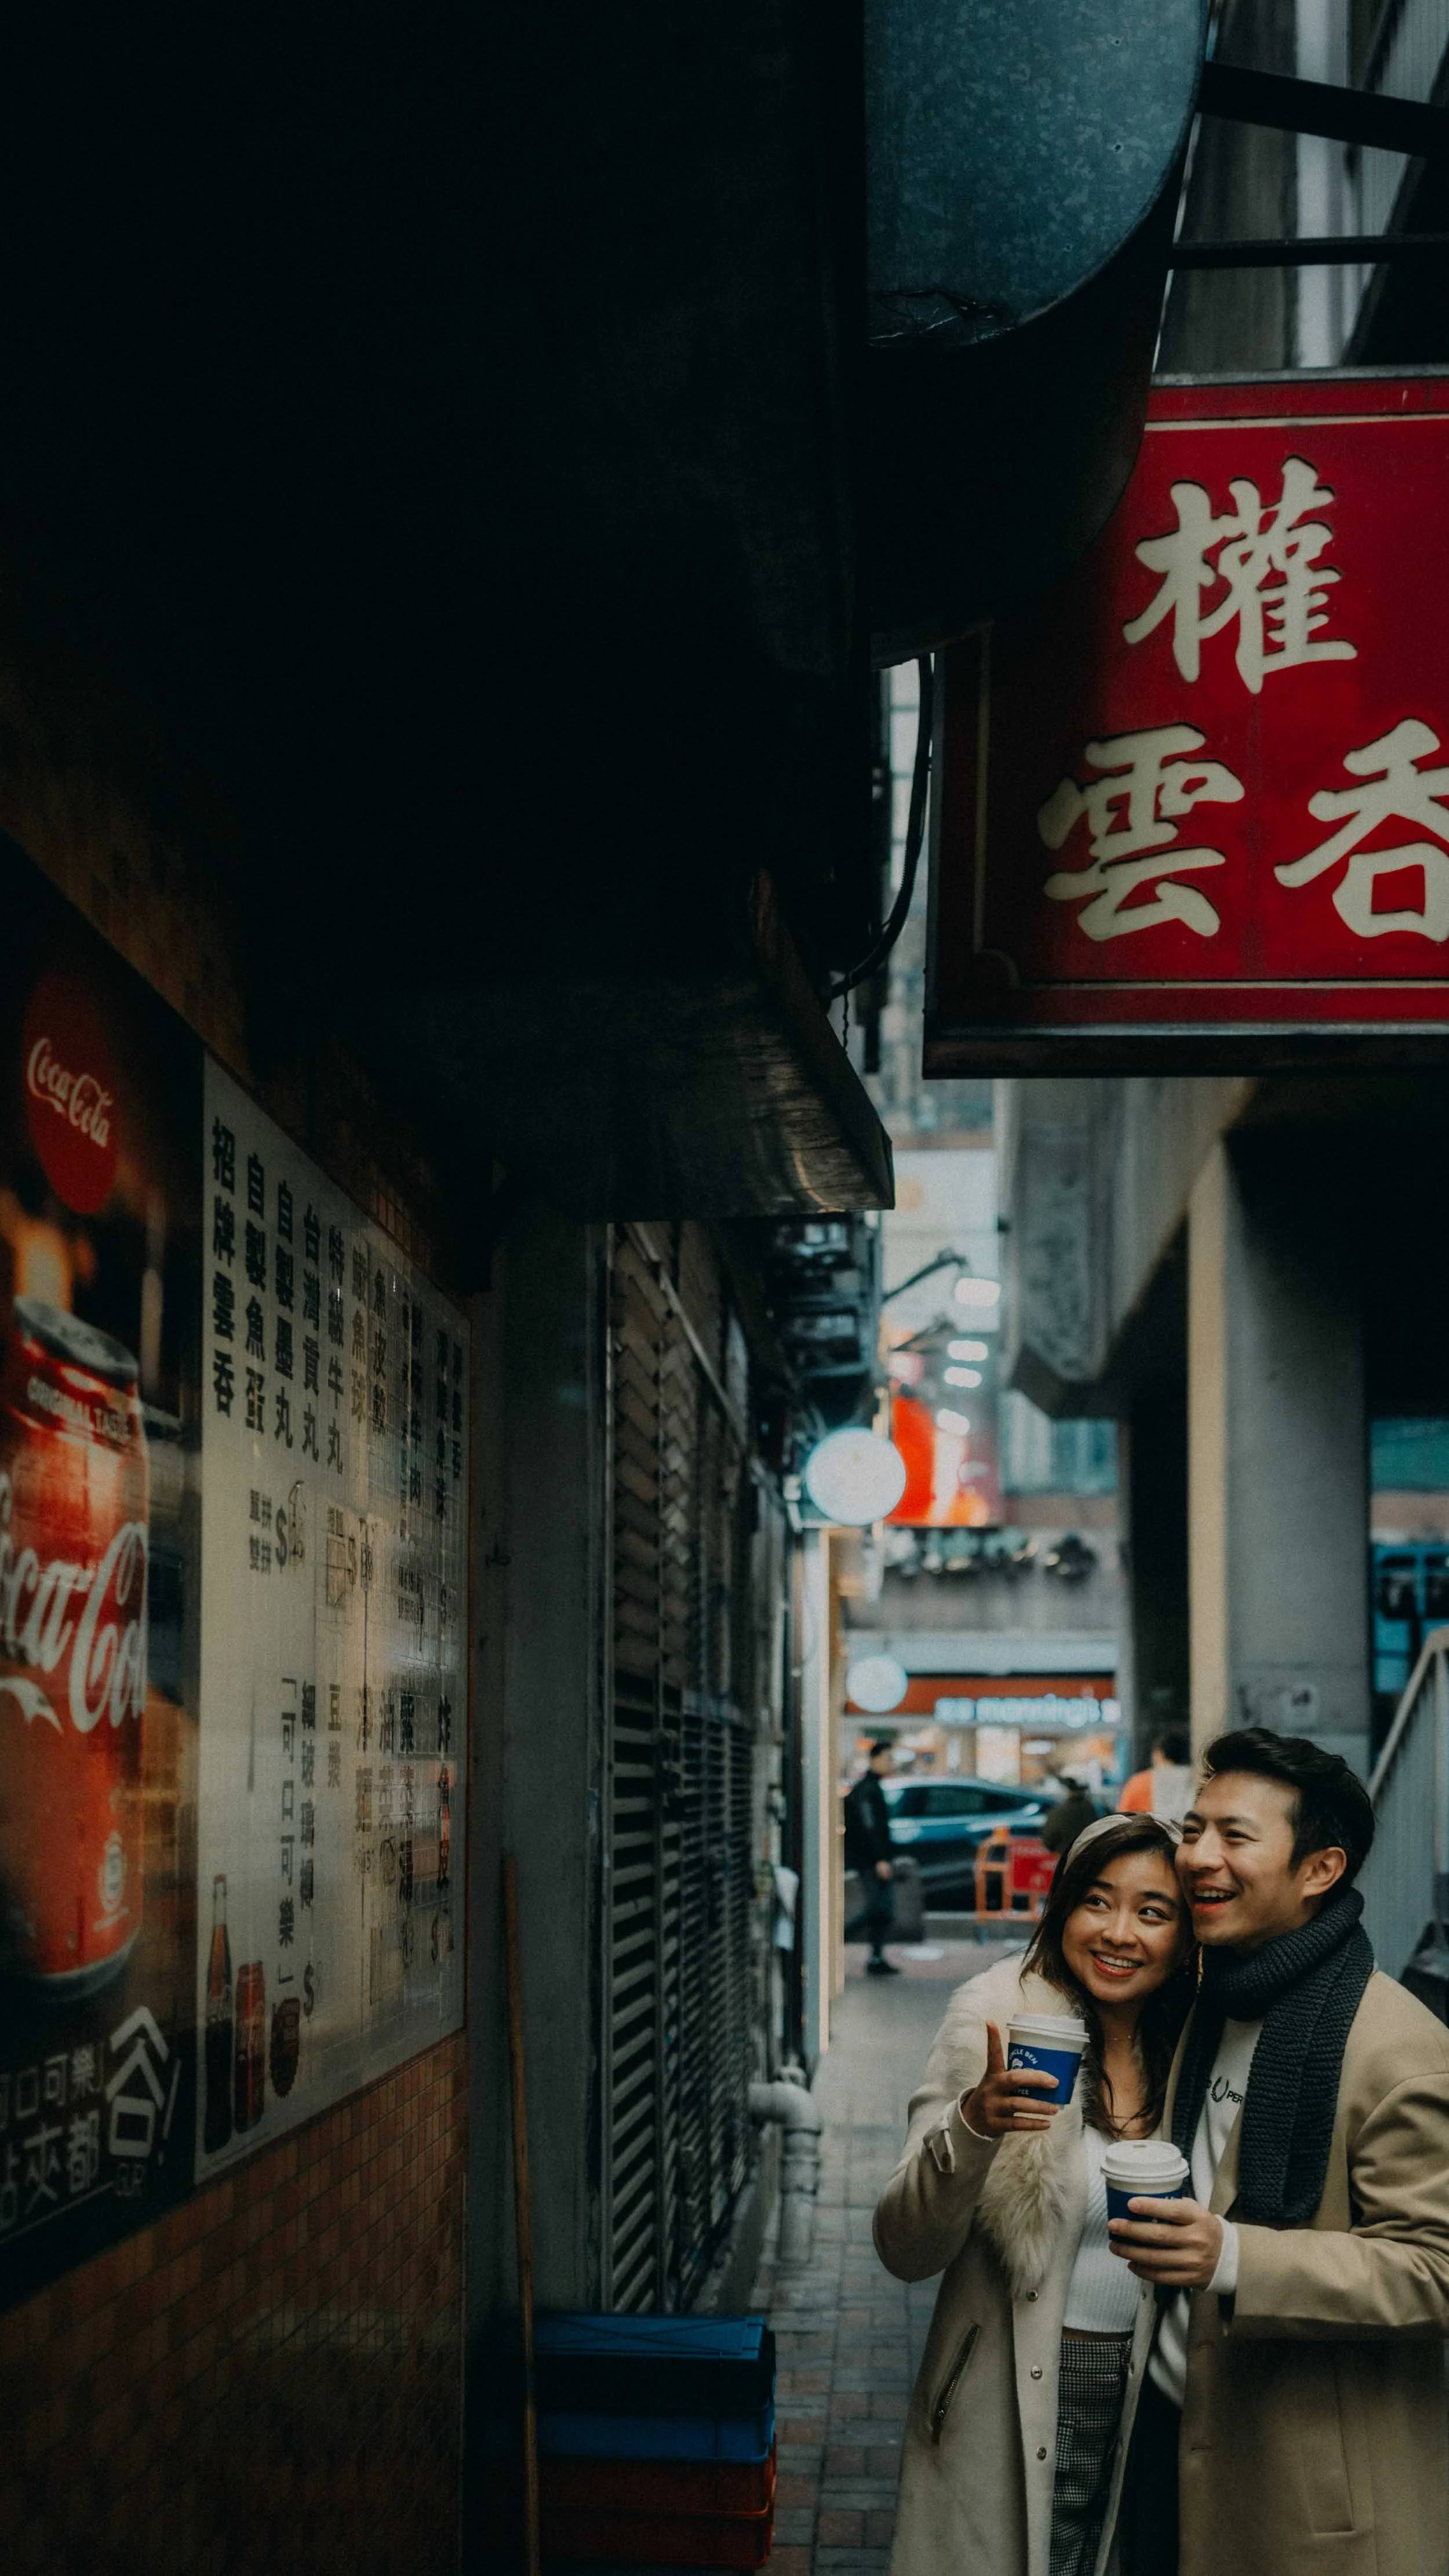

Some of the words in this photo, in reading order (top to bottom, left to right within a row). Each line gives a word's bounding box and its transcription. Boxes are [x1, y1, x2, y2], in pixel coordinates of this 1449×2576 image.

[1123, 455, 1359, 695] 權
[1037, 717, 1449, 943] 雲吞
[212, 1116, 235, 1417] 招牌雲吞
[246, 1152, 266, 1433] 自製魚蛋
[275, 1179, 293, 1449] 自製墨丸
[303, 1202, 321, 1464] 台灣貢丸
